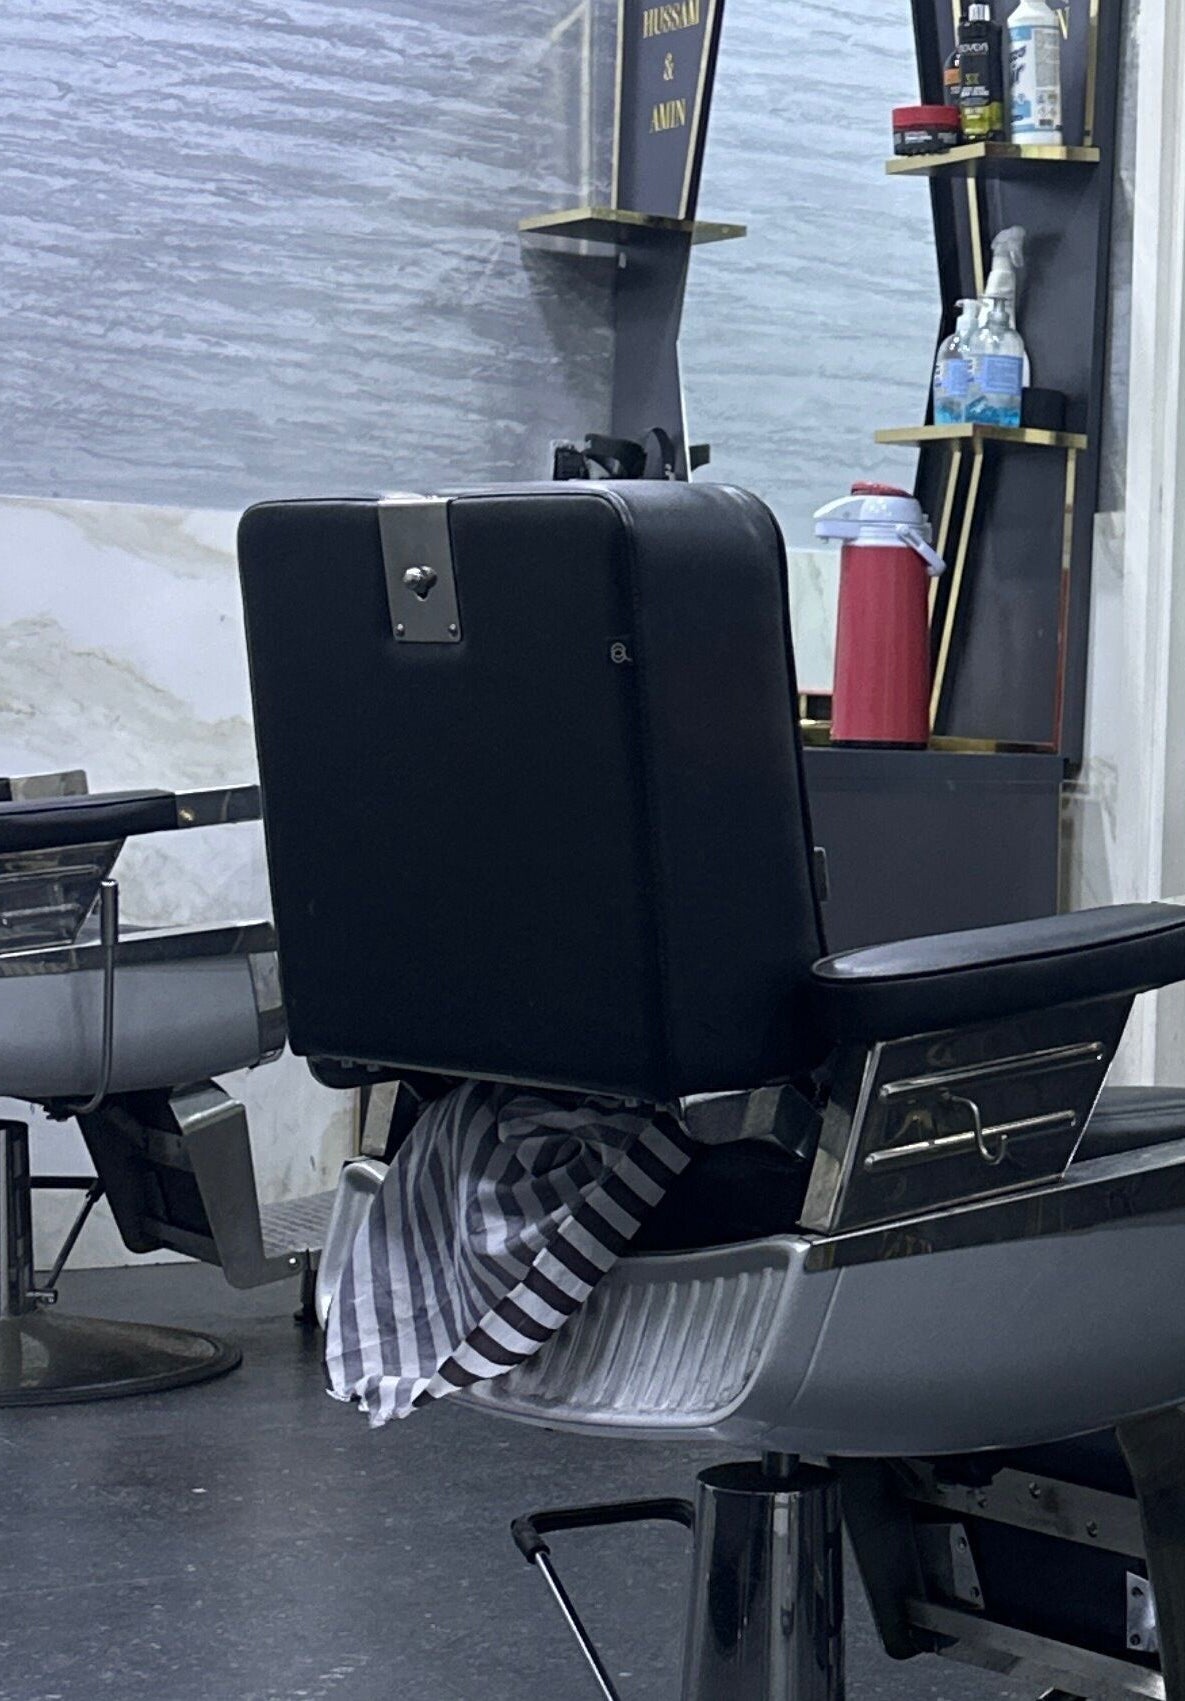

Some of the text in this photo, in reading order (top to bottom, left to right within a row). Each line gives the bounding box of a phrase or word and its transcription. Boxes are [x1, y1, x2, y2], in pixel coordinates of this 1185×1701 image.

[642, 0, 700, 39] HUSSAM
[663, 52, 675, 81] &
[649, 98, 686, 134] AMIN
